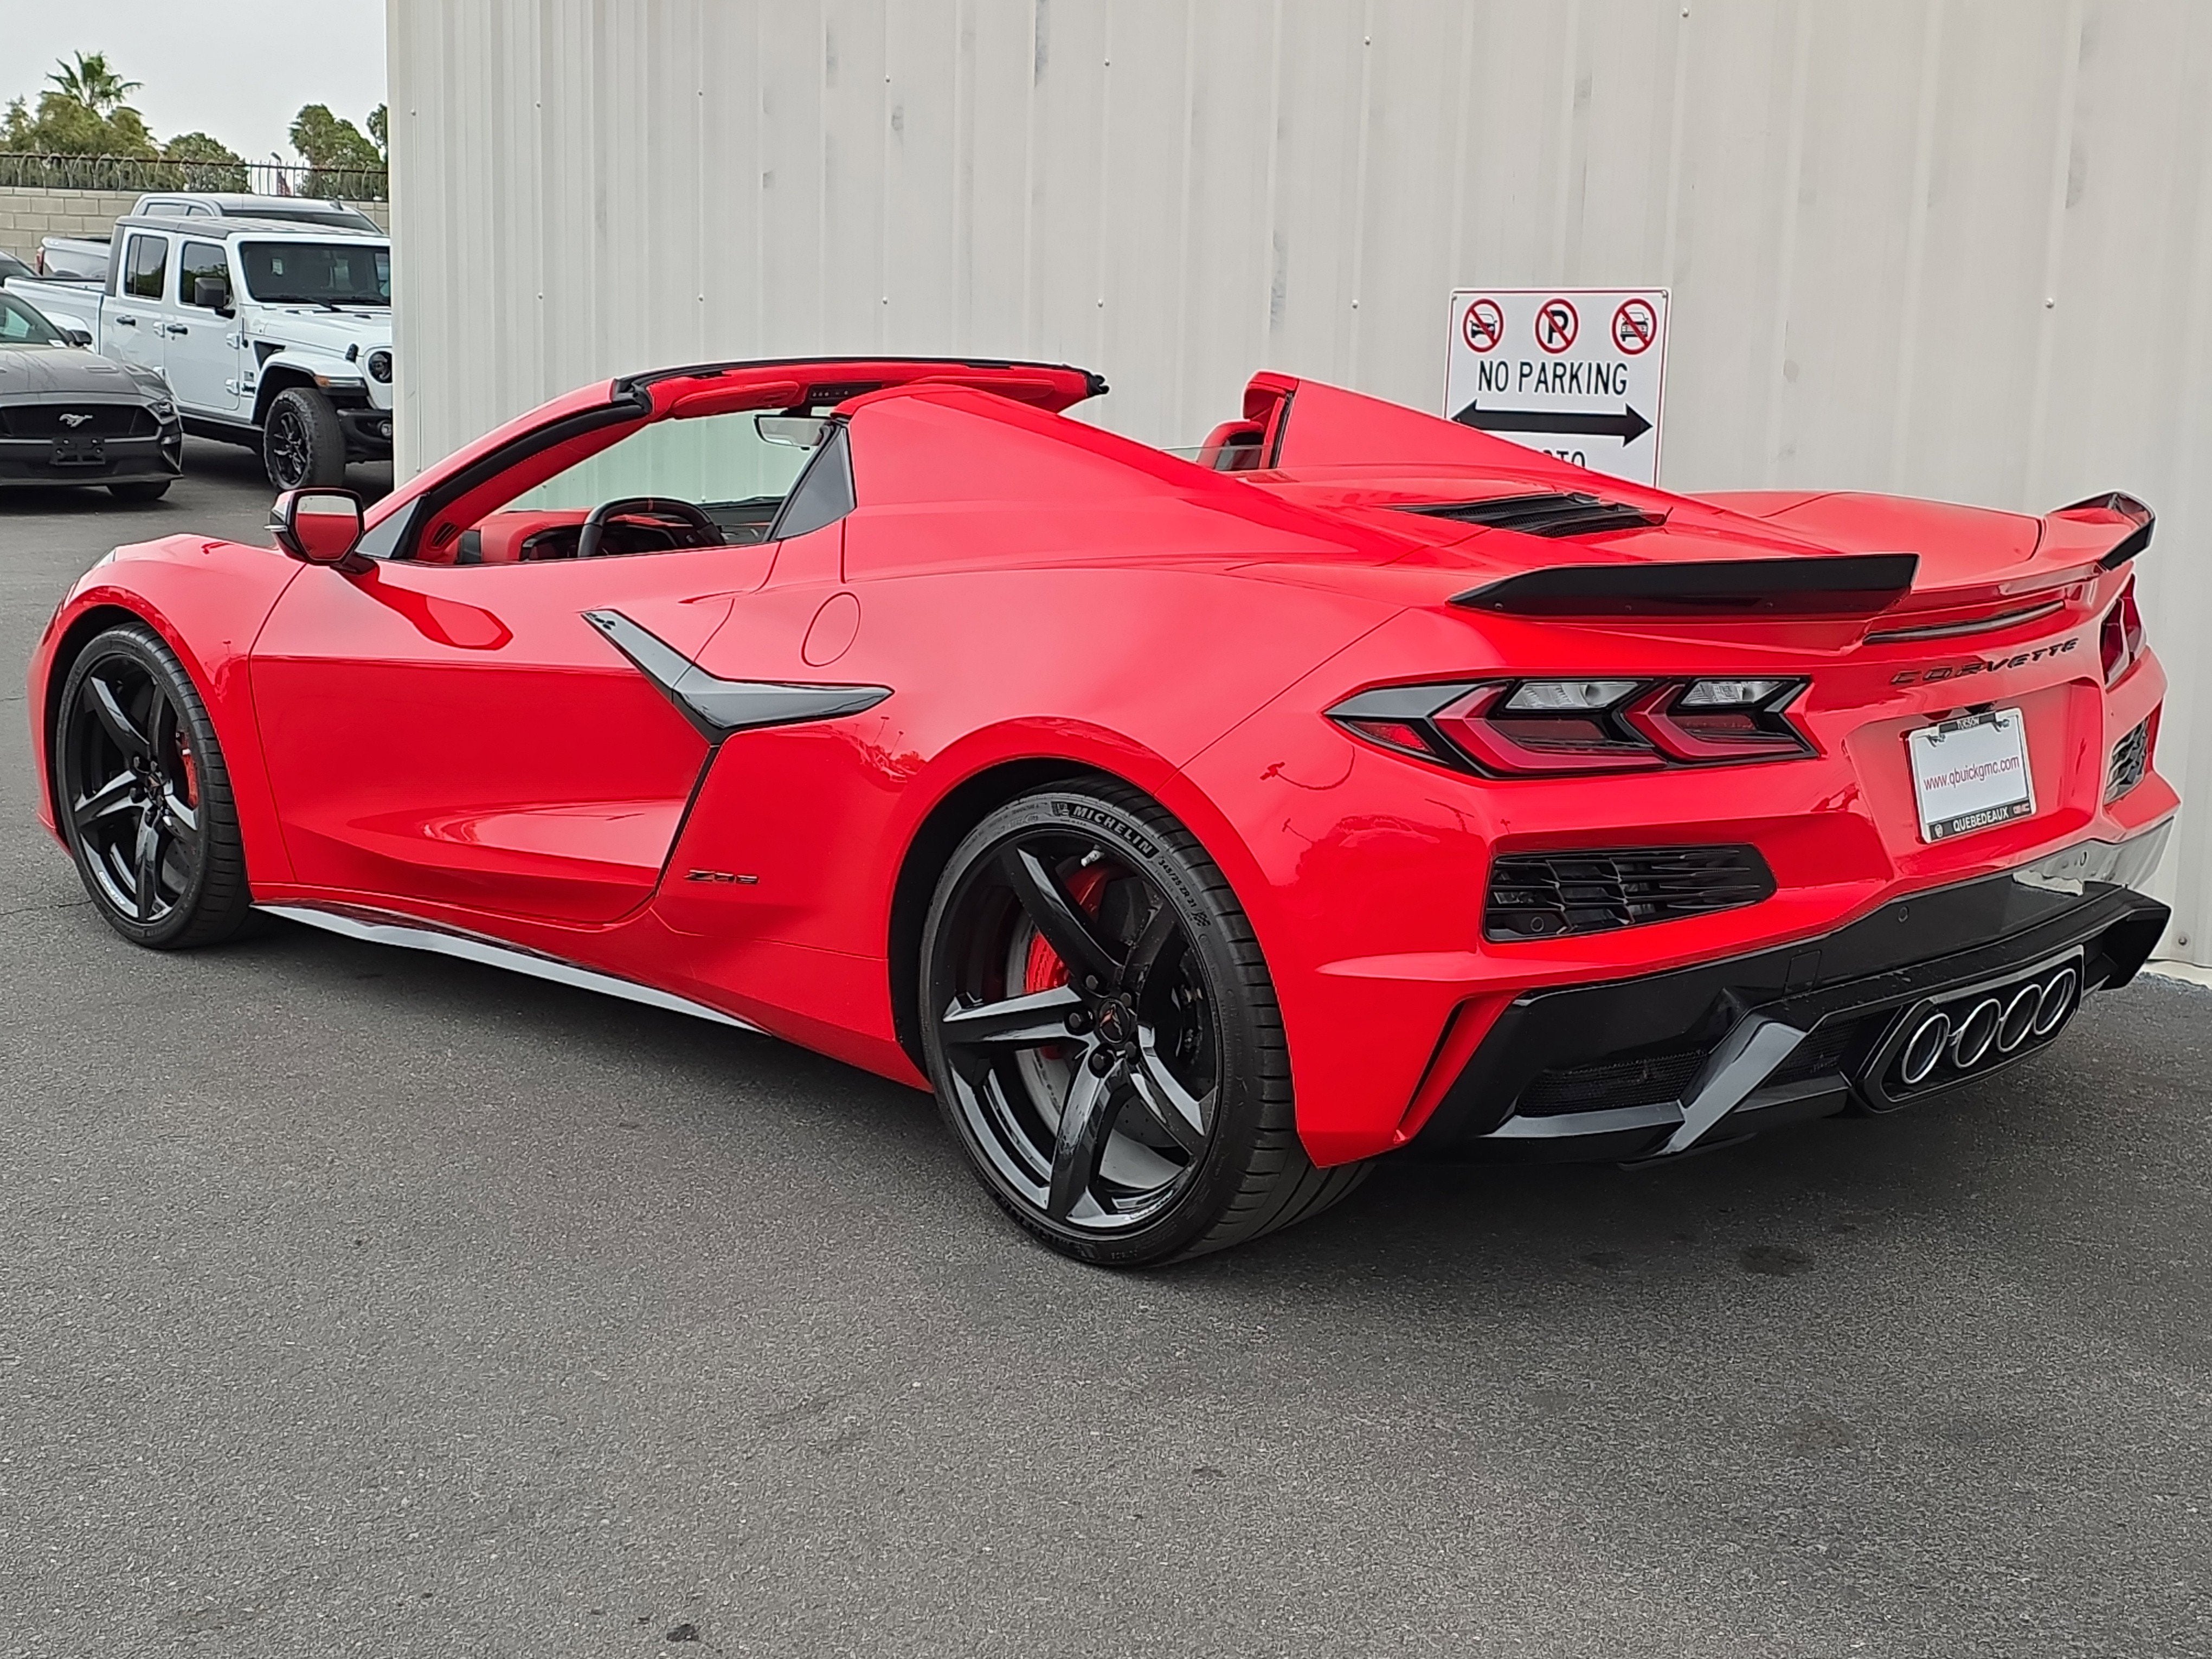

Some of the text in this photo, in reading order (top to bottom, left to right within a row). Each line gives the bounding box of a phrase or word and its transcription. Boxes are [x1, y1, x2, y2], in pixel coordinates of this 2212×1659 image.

[1478, 360, 1628, 395] NO PARKING
[1891, 638, 2079, 685] CORVETTE
[1923, 756, 2020, 791] www.qbuickgmc.com
[1073, 805, 1153, 854] MICHELIN
[1953, 806, 2009, 832] QUEBEDEAUX
